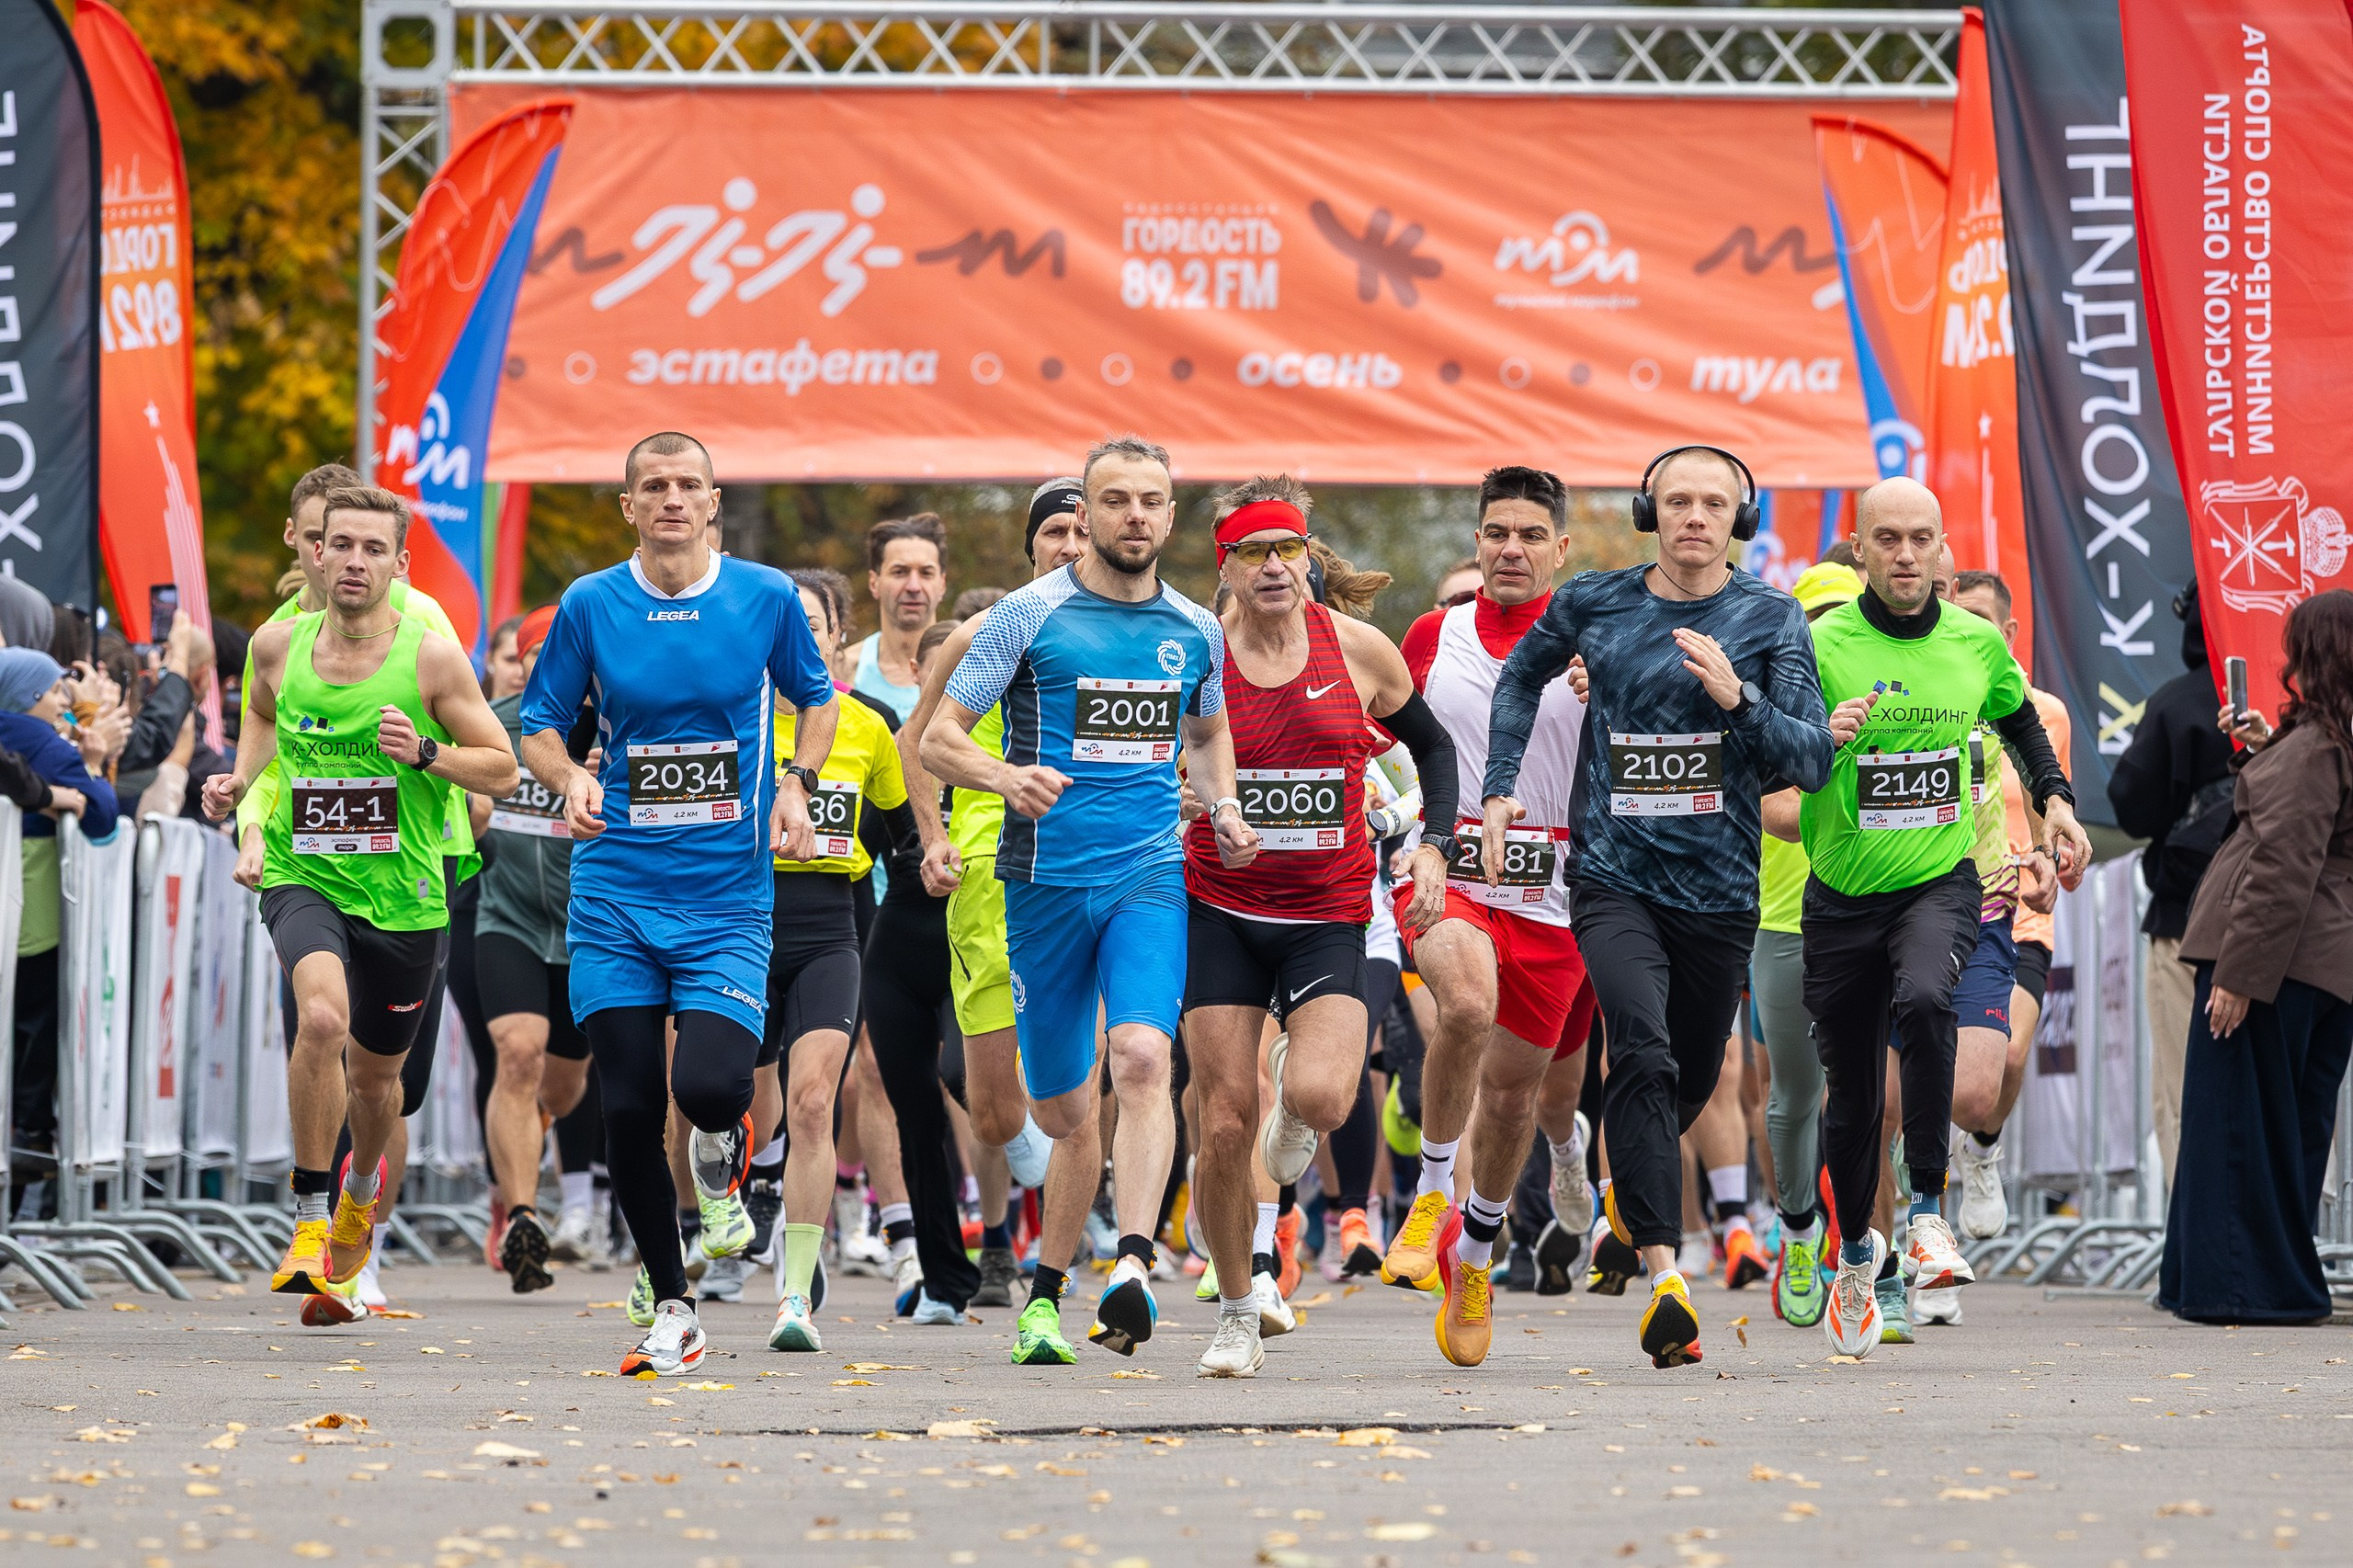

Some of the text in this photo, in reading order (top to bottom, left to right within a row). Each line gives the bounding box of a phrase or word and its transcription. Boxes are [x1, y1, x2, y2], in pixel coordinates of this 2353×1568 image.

[1122, 216, 1283, 255] ГОРДОСТЬ
[626, 337, 939, 396] эстафета
[1235, 352, 1404, 390] осень
[1690, 356, 1843, 404] тула
[646, 609, 699, 621] LEGEA
[1087, 699, 1170, 727] 2001
[290, 742, 388, 759] К-ХОЛДИН
[1623, 753, 1708, 779] 2102
[640, 761, 729, 794] 2034
[1871, 767, 1950, 799] 2149
[305, 796, 385, 827] 54-1
[808, 793, 847, 826] 36
[1244, 783, 1336, 814] 2060
[1458, 843, 1543, 873] 281
